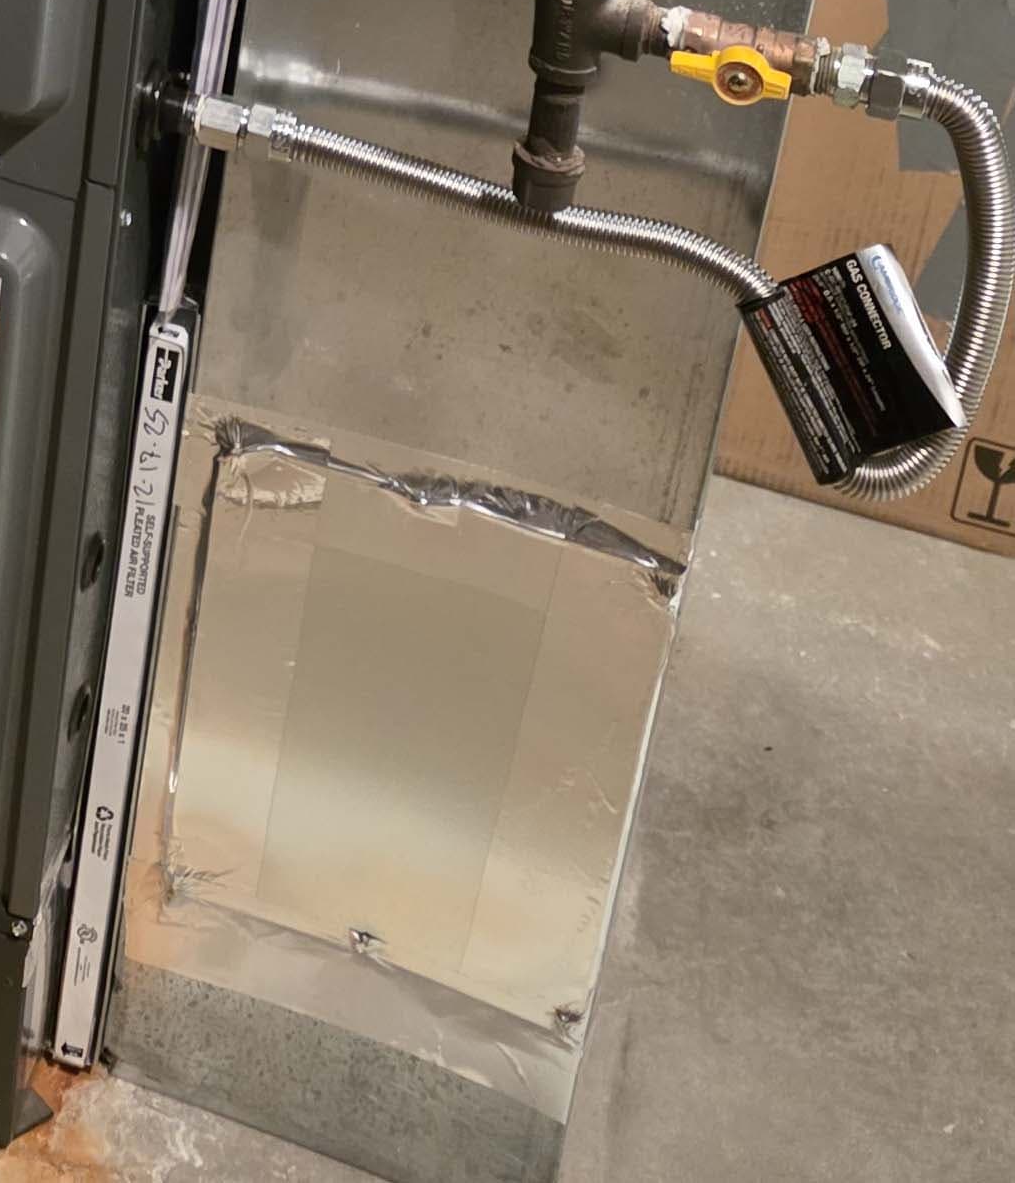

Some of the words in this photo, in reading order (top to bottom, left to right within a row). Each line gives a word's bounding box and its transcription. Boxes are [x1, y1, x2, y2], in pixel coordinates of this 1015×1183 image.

[845, 259, 865, 284] GAS
[856, 283, 893, 351] CONNECTOR
[131, 506, 145, 548] PLEATED
[129, 549, 139, 565] AIR
[136, 514, 156, 595] SELF-SUPPORTED
[125, 566, 137, 598] FILTER
